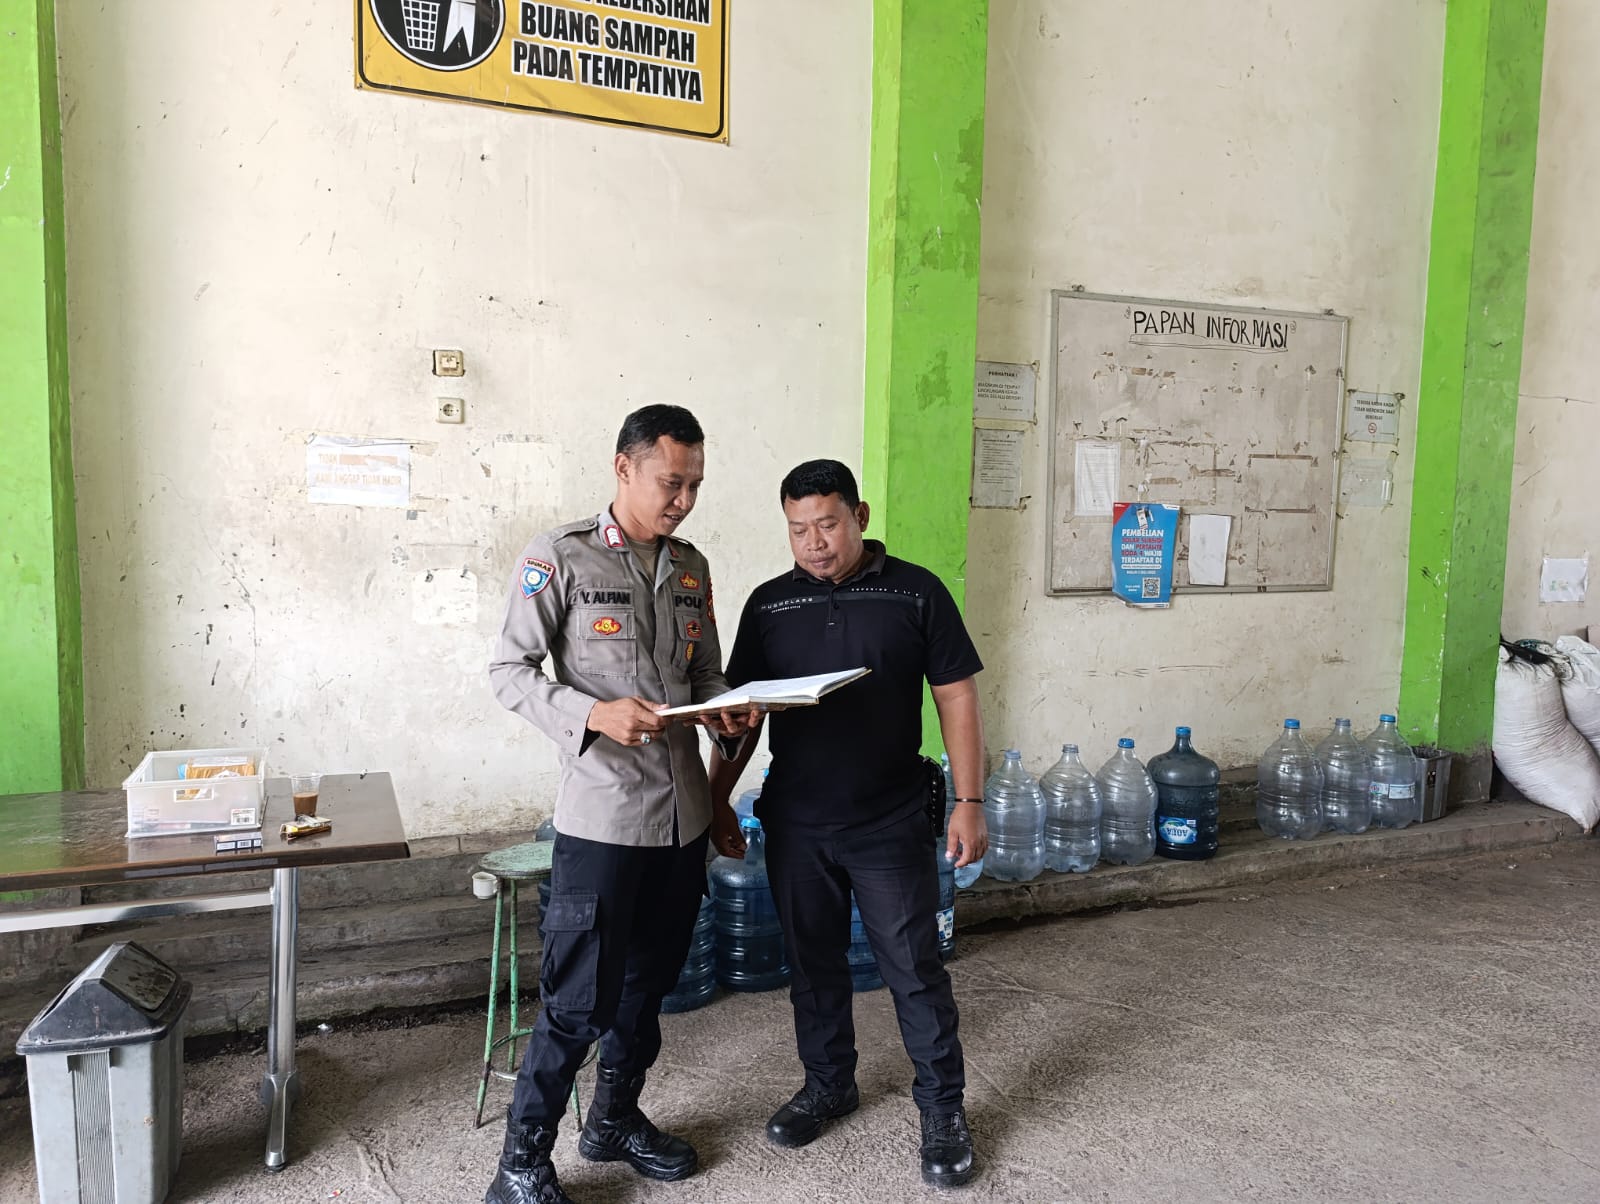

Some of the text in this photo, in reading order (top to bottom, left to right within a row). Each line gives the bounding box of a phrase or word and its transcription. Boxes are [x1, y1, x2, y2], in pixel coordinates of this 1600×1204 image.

[597, 0, 710, 24] SIHAN
[521, 2, 695, 63] BUANG SAMPAH
[513, 41, 702, 102] PADA TEMPATNYA
[1134, 310, 1195, 335] PAPAN
[1122, 529, 1164, 537] PEMBELIAN
[1121, 556, 1154, 564] TERDAFTAR
